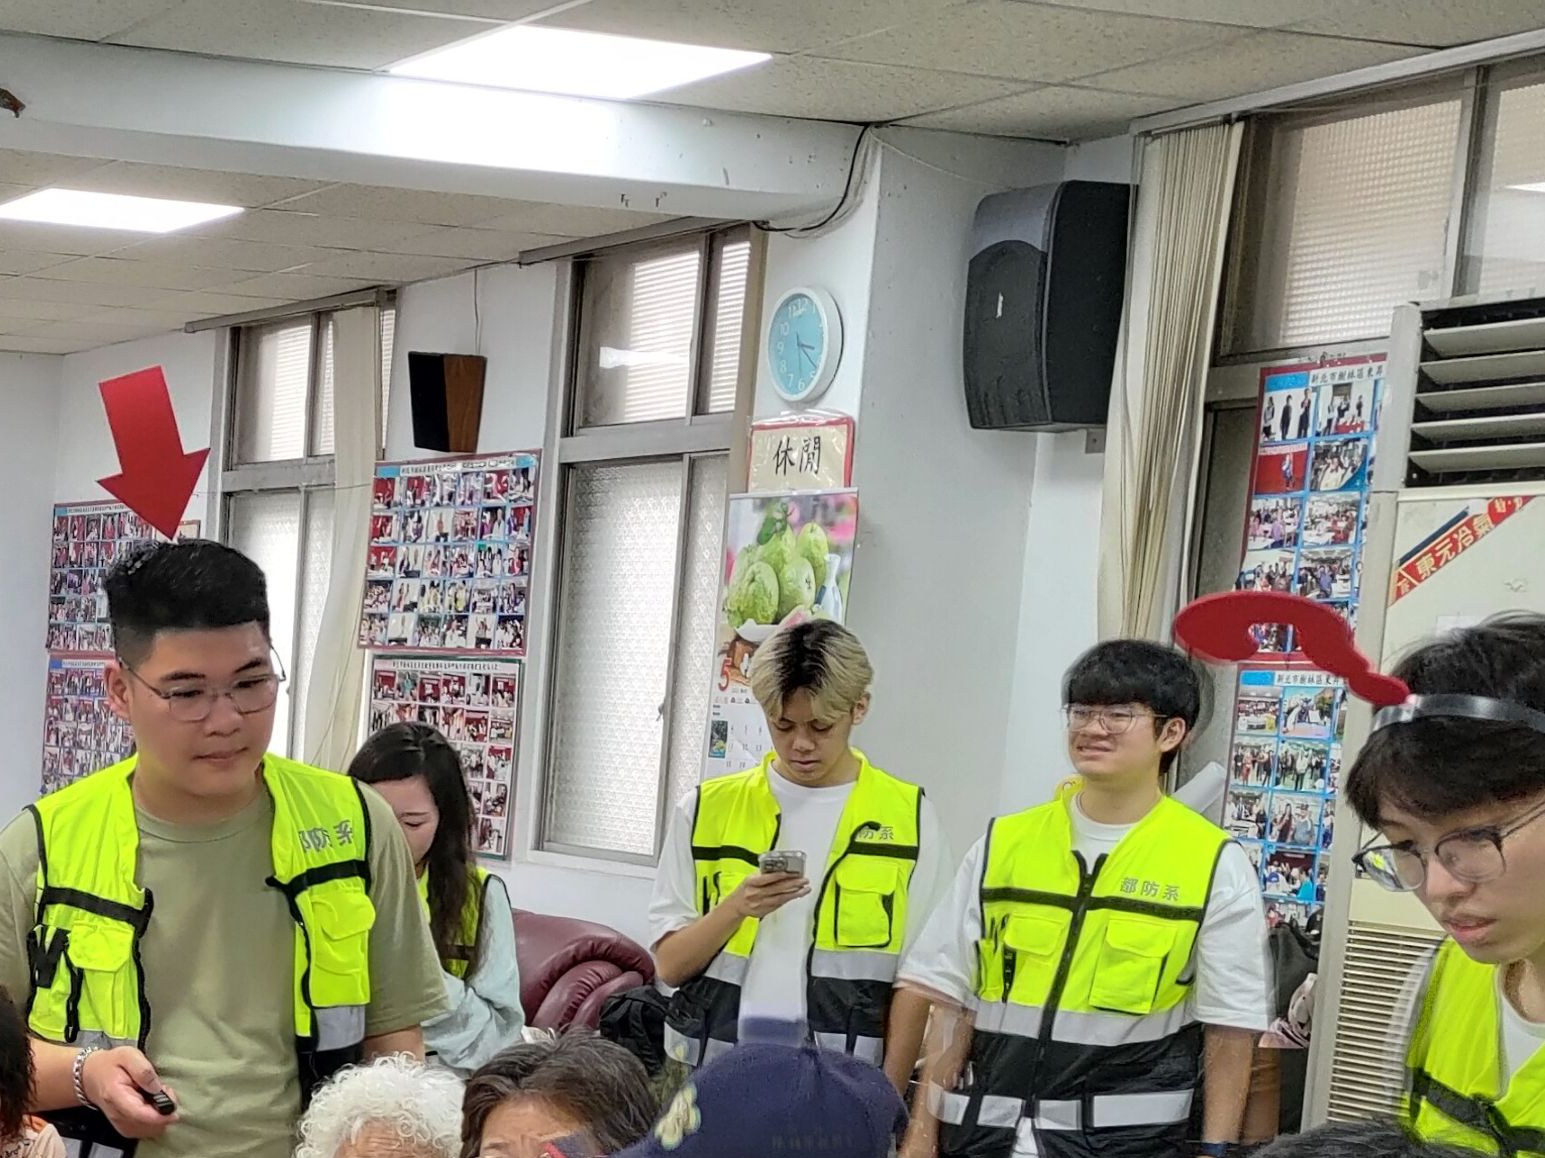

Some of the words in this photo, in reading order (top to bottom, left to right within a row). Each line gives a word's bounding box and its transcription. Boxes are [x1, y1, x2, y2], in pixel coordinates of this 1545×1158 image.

[718, 656, 734, 692] 5
[1120, 876, 1180, 901] 都防系
